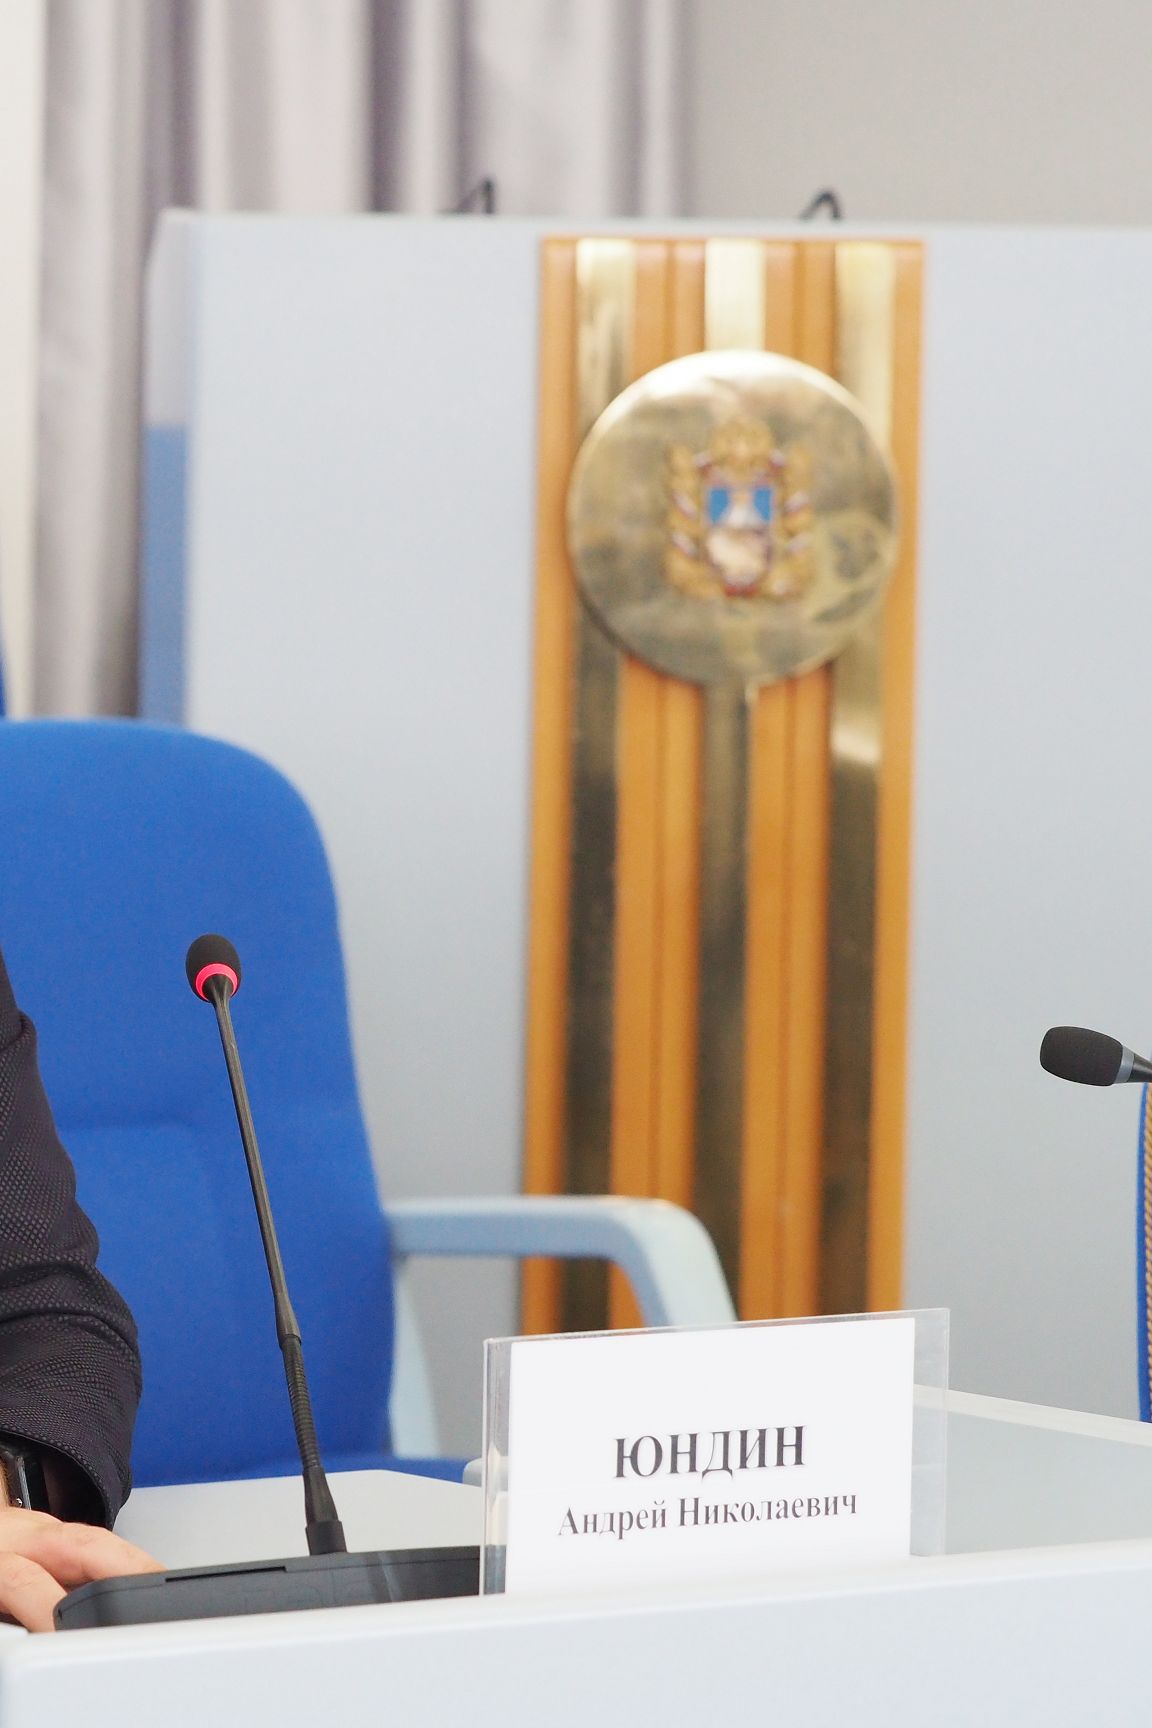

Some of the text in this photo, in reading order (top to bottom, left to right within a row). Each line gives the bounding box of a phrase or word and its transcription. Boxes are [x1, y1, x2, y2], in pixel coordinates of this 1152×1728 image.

[614, 1425, 806, 1480] ЮНДИН
[558, 1494, 858, 1541] Андрей Николаевич
